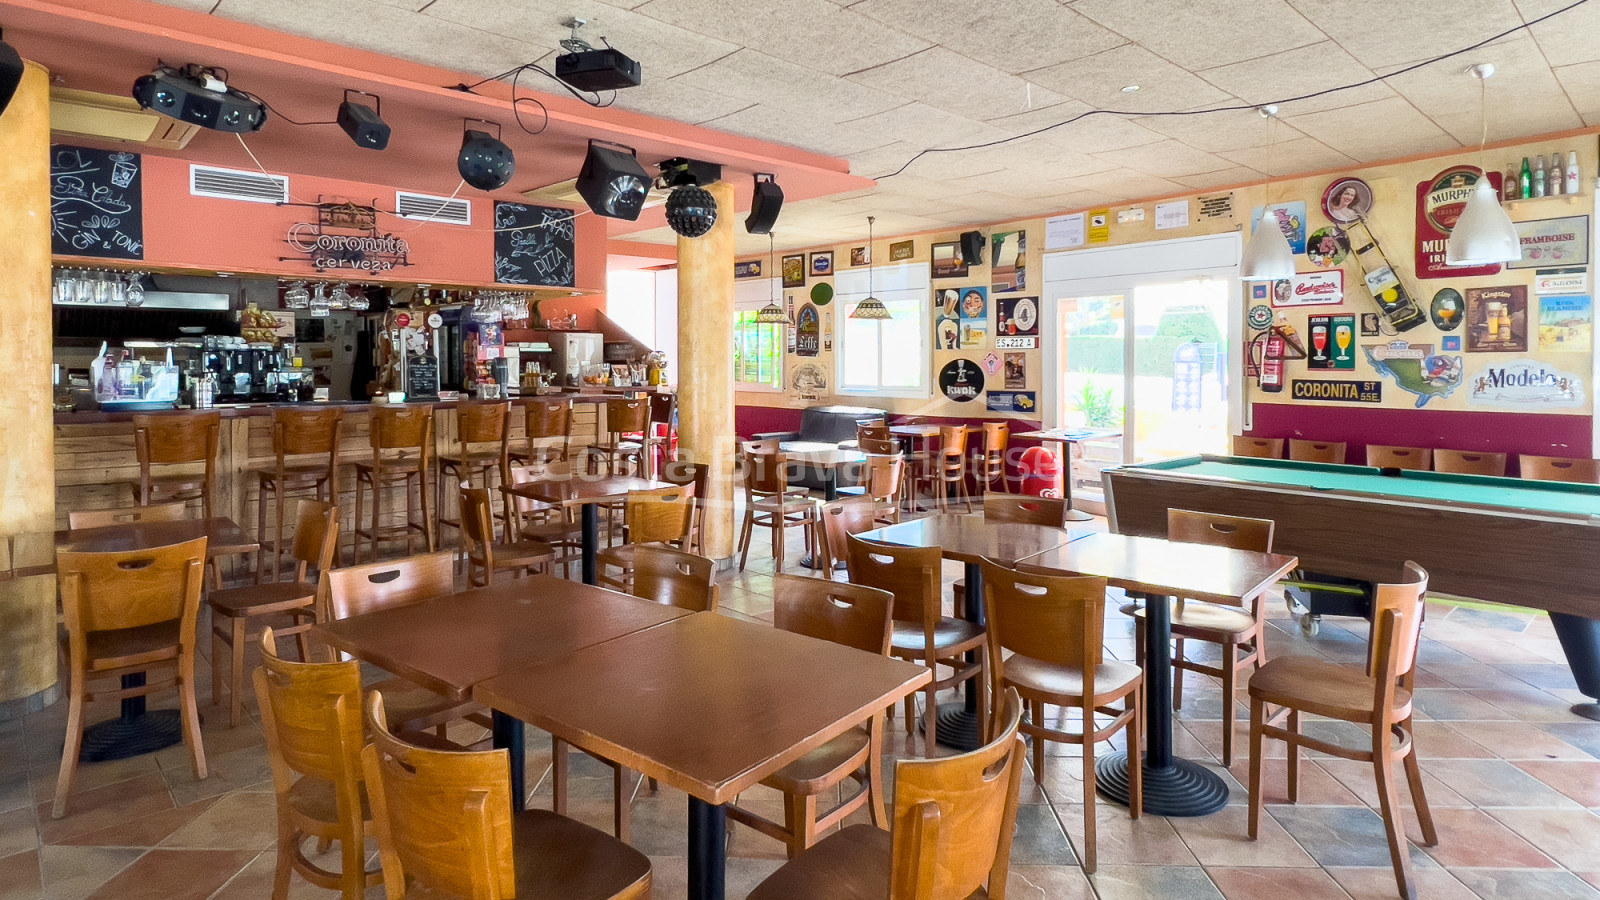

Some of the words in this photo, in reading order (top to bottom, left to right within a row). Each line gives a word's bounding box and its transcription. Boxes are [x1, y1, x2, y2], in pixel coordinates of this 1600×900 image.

[1432, 189, 1476, 204] MURPH
[288, 222, 410, 253] Coronita
[1519, 233, 1575, 245] FRAMBOISE
[315, 257, 392, 271] cerveza
[798, 335, 818, 350] Leffe
[1488, 368, 1558, 388] Modelo
[1295, 383, 1358, 398] CORONITA
[1364, 383, 1376, 391] ST
